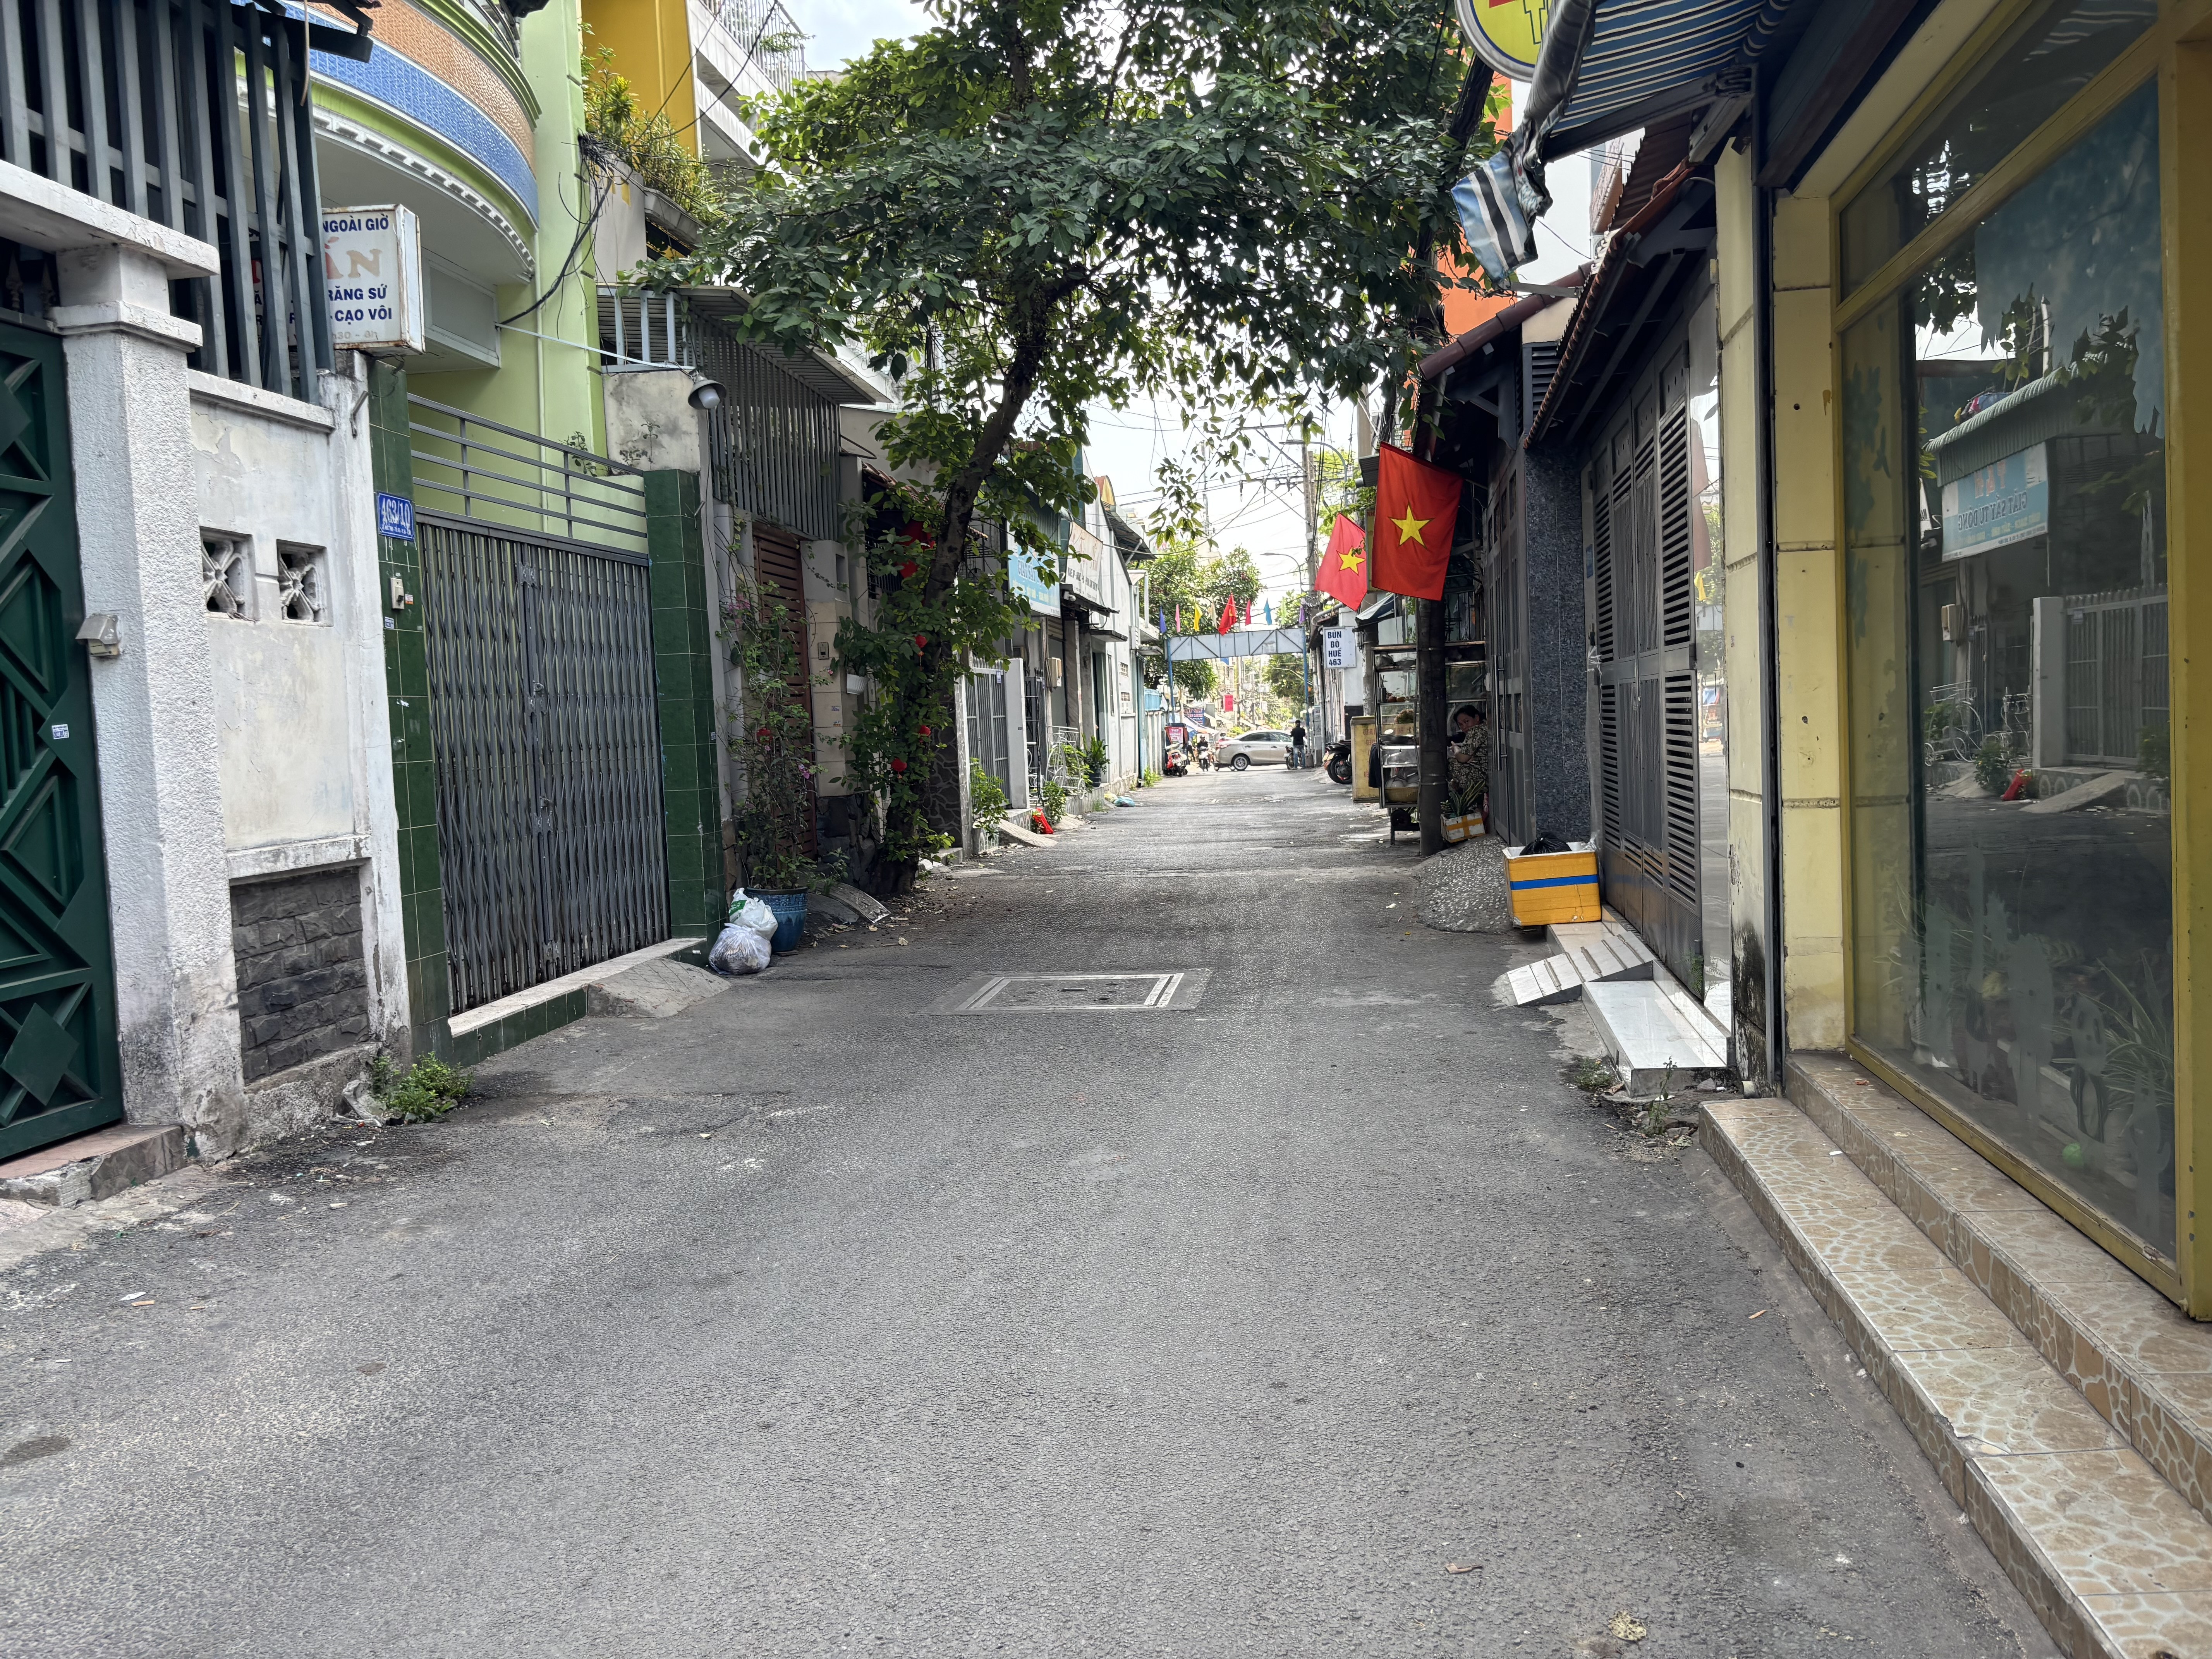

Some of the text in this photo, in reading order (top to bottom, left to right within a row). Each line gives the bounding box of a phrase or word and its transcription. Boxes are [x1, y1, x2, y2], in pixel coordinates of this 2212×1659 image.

[366, 213, 388, 231] GIỜ
[368, 283, 387, 299] SỨ
[335, 305, 392, 325] CẠO VÔI
[1331, 639, 1340, 648] BÒ
[1328, 647, 1341, 657] HUẾ
